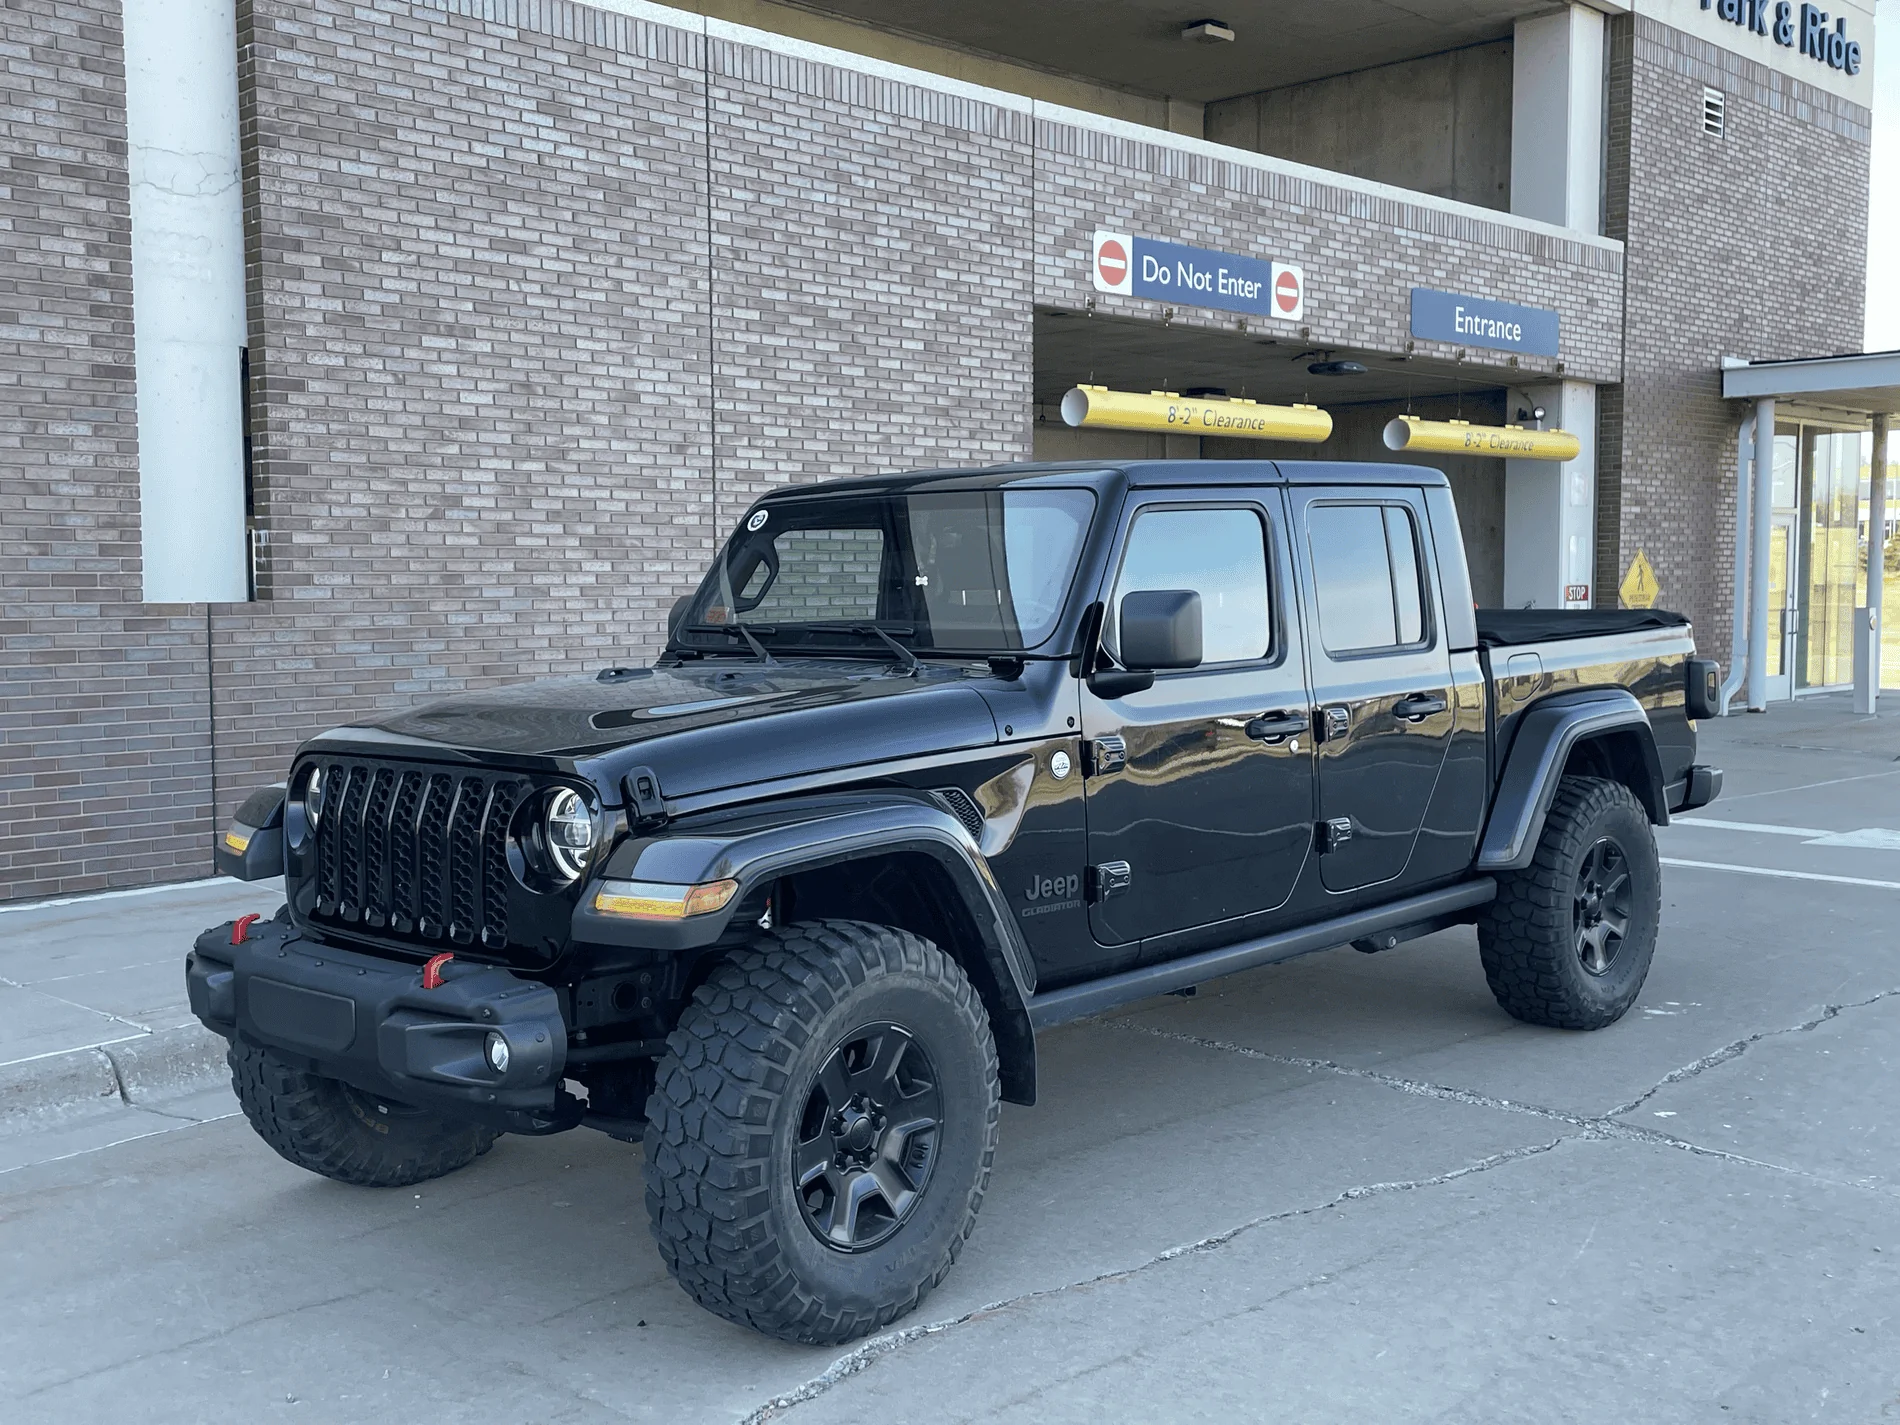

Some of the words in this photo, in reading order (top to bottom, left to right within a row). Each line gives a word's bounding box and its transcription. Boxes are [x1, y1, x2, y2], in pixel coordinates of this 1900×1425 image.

[1700, 0, 1768, 36] ark
[1773, 1, 1795, 47] &
[1799, 3, 1861, 75] Ride
[1142, 254, 1171, 284] Do
[1177, 260, 1212, 292] Not
[1218, 268, 1262, 299] Enter
[1455, 306, 1521, 341] Entrance
[1203, 408, 1266, 431] Clearance
[1489, 433, 1534, 452] Clearance
[1568, 586, 1586, 600] STOP
[1025, 874, 1079, 900] Jeep
[1021, 899, 1081, 917] GLADIATOR
